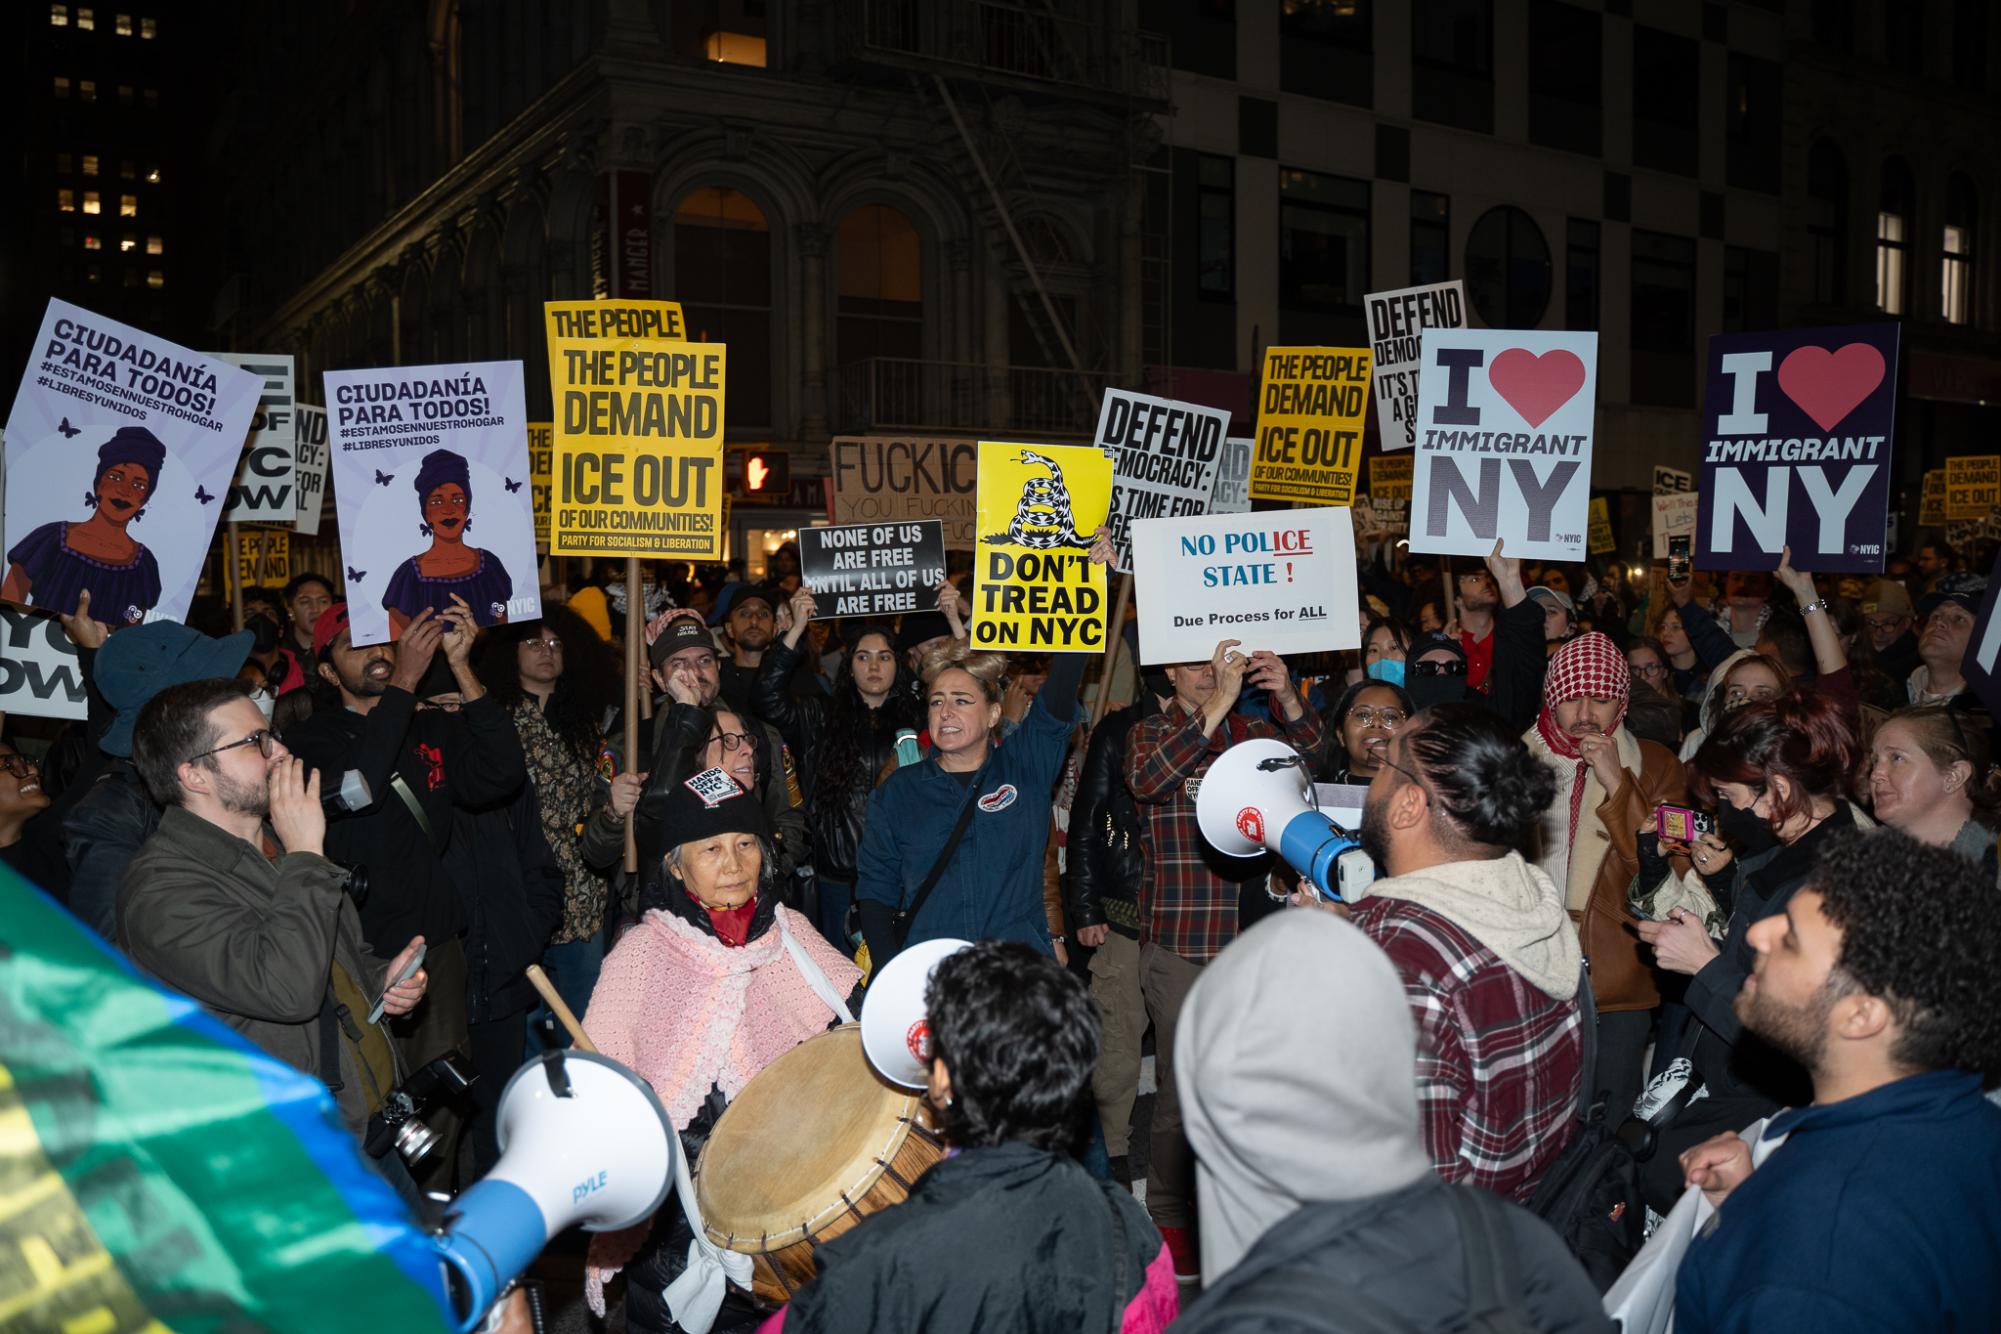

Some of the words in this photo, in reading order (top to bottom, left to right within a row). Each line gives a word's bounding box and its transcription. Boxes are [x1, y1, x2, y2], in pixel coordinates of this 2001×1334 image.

[552, 310, 597, 338] THE
[600, 308, 681, 338] PEOPLE
[1371, 288, 1462, 342] DEFEND
[53, 318, 218, 394] CIUDADANÍA
[1270, 355, 1300, 379] THE
[1300, 355, 1368, 381] PEOPLE
[45, 339, 118, 383] PARA
[127, 368, 216, 415] TODOS!
[564, 350, 615, 386] THE
[619, 351, 719, 390] PEOPLE
[37, 375, 148, 421] #LIBRESYUNIDOS
[40, 361, 224, 433] #ESTAMOSENNUESTROHOGAR
[336, 372, 487, 404] CIUDADANÍA
[1379, 372, 1407, 399] IT'S
[1433, 348, 1484, 426] I
[1717, 351, 1773, 436] I
[338, 405, 403, 426] PARA
[409, 398, 491, 421] TODOS!
[1265, 383, 1363, 417] DEMAND
[1393, 398, 1402, 422] A
[340, 417, 504, 438] #ESTAMOSENNUESTROHOGAR
[564, 391, 717, 439] DEMAND
[1102, 396, 1222, 462] DEFEND
[342, 435, 440, 452] #LIBRESYUNIDOS
[1258, 426, 1298, 463] ICE
[1301, 428, 1358, 468] OUT
[1422, 430, 1587, 456] IMMIGRANT
[1705, 436, 1885, 462] IMMIGRANT
[561, 452, 625, 505] ICE
[633, 454, 714, 508] OUT
[835, 441, 939, 494] FUCK
[1255, 466, 1266, 478] OF
[1266, 466, 1284, 480] OUR
[1284, 467, 1352, 486] COMMUNITIES!
[1949, 471, 1998, 485] DEMAND
[1656, 470, 1689, 493] ICE
[841, 498, 892, 518] YOU
[1128, 488, 1170, 518] TIME
[1426, 455, 1582, 542] NY
[1710, 464, 1879, 554] NY
[1949, 489, 1969, 504] ICE
[1972, 488, 1997, 503] OUT
[559, 509, 578, 529] OF
[578, 510, 608, 529] OUR
[610, 511, 714, 533] COMMUNITIES!
[561, 534, 588, 547] PARTY
[589, 535, 605, 547] FOR
[607, 536, 651, 548] SOCIALISM
[654, 538, 660, 548] &
[662, 538, 710, 550] LIBERATION
[820, 529, 868, 549] NONE
[872, 527, 894, 545] OF
[899, 525, 922, 543] US
[1181, 534, 1215, 557] NO
[1225, 529, 1313, 554] POLICE
[1563, 534, 1582, 544] NYIC
[1860, 544, 1880, 555] NYIC
[833, 550, 867, 570] ARE
[871, 548, 914, 567] FREE
[989, 552, 1091, 583] DON'T
[860, 572, 892, 591] ALL
[895, 570, 917, 589] OF
[922, 568, 945, 587] US
[1203, 563, 1277, 587] STATE
[1287, 562, 1293, 583] !
[507, 597, 535, 617] NYIC
[836, 595, 870, 614] ARE
[874, 592, 916, 612] FREE
[981, 584, 1099, 614] TREAD
[1174, 615, 1204, 627] Due
[1209, 611, 1270, 625] Process
[1274, 608, 1295, 620] for
[1299, 606, 1327, 619] ALL
[976, 621, 1018, 644] ON
[1030, 618, 1101, 645] NYC
[688, 768, 722, 787] HANDS
[695, 778, 714, 790] OFF
[700, 783, 722, 796] NYC
[572, 1171, 607, 1204] PYLE
